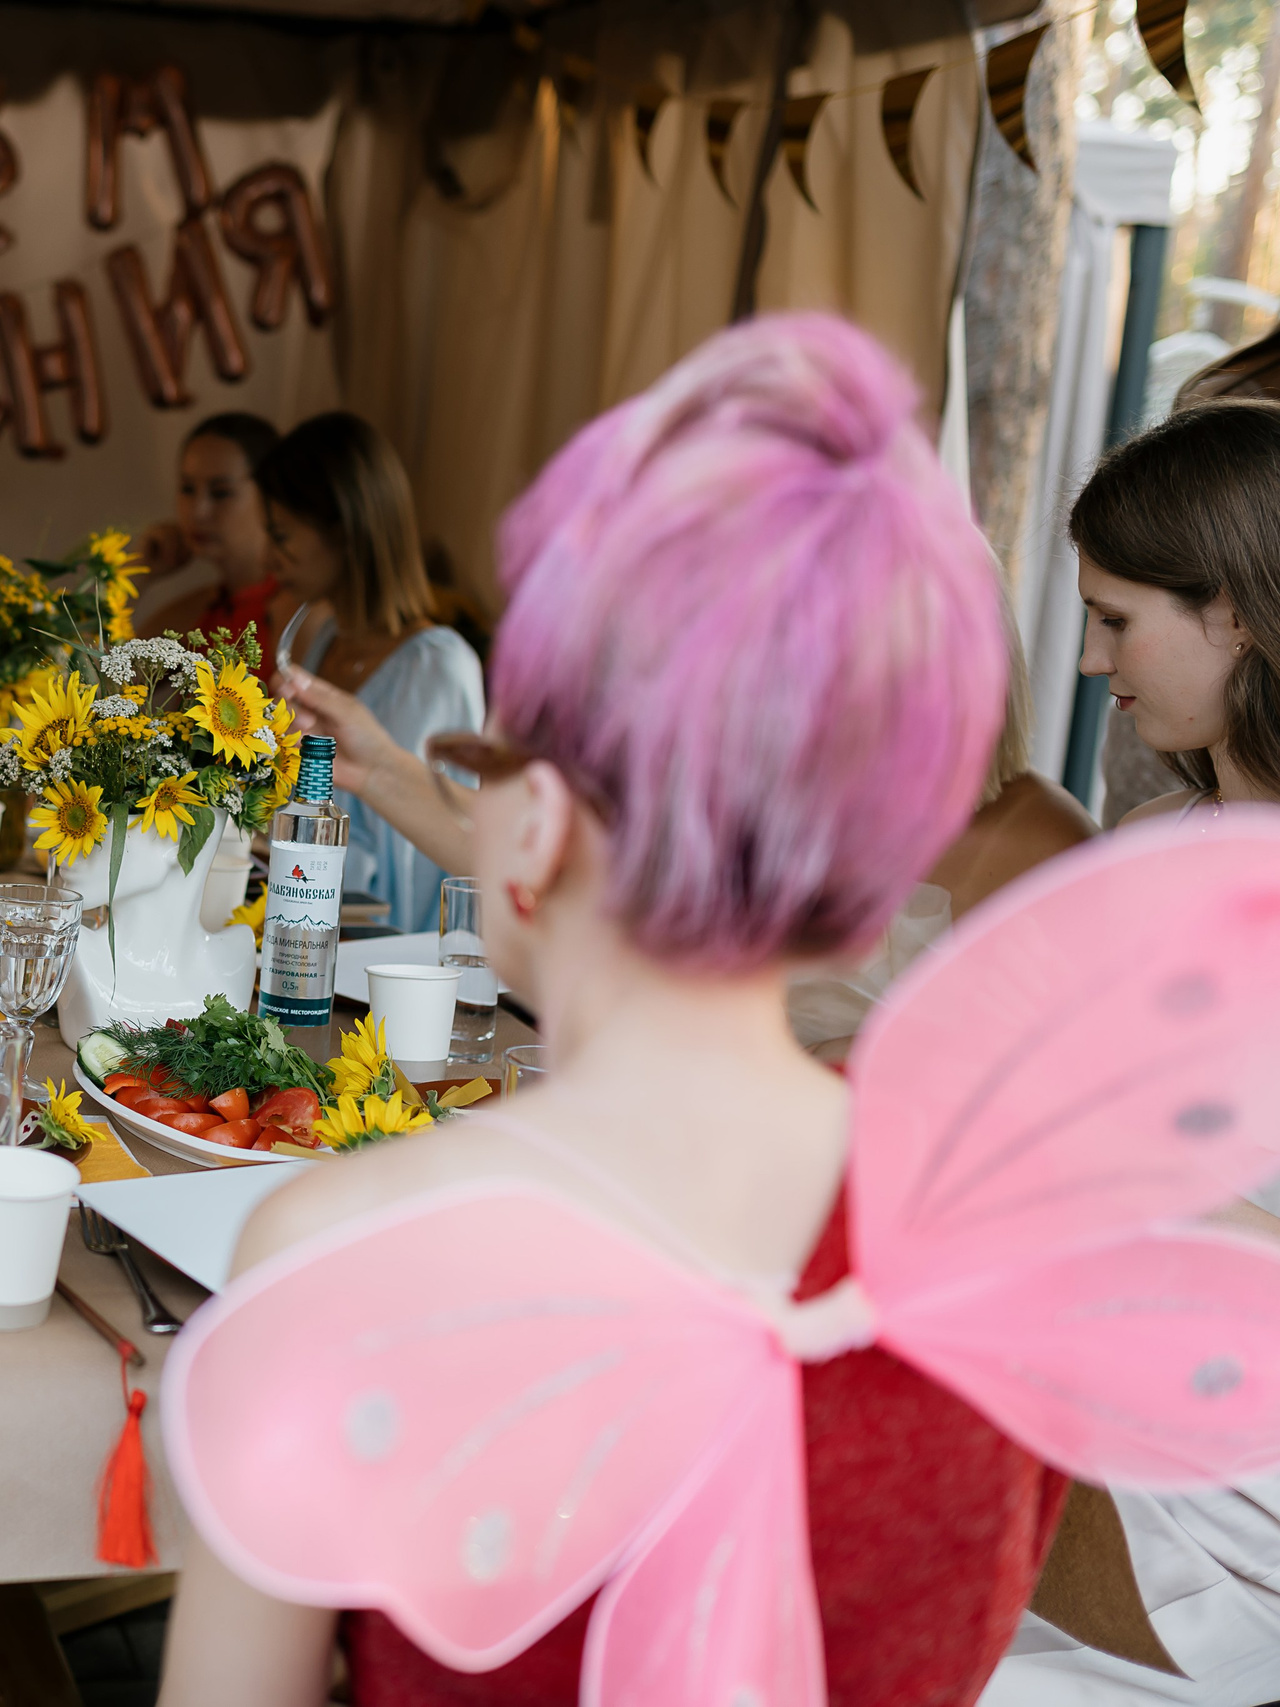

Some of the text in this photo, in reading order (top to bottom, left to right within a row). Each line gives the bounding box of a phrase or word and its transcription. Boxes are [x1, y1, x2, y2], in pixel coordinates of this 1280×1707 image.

[278, 937, 329, 950] МИНЕРАЛЬНАЯ
[278, 951, 309, 960] ПРИРОДНАЯ
[269, 967, 318, 979] ГАЗИРОВАННАЯ
